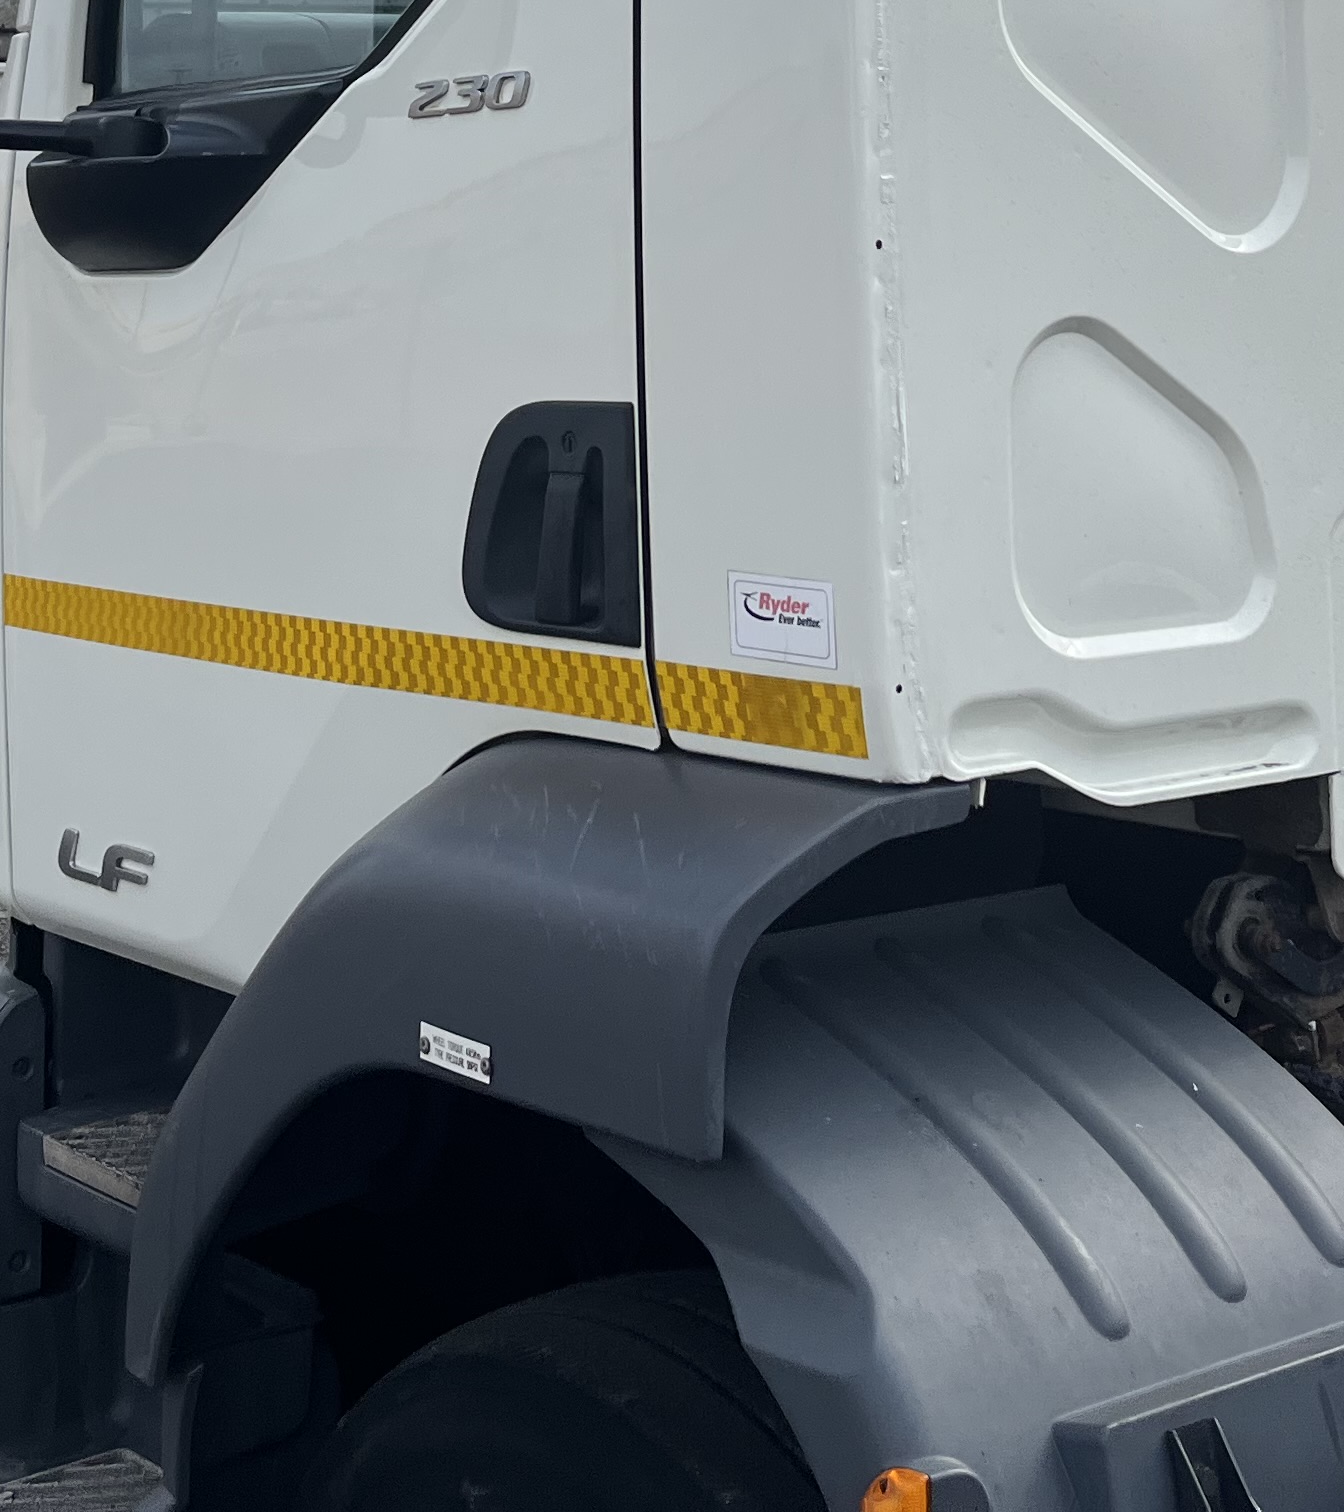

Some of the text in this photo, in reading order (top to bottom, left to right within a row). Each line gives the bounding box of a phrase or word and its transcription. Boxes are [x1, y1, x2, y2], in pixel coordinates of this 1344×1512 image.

[408, 70, 531, 119] 230
[758, 592, 810, 615] Ryder
[778, 613, 795, 625] Ever
[58, 827, 155, 892] LF
